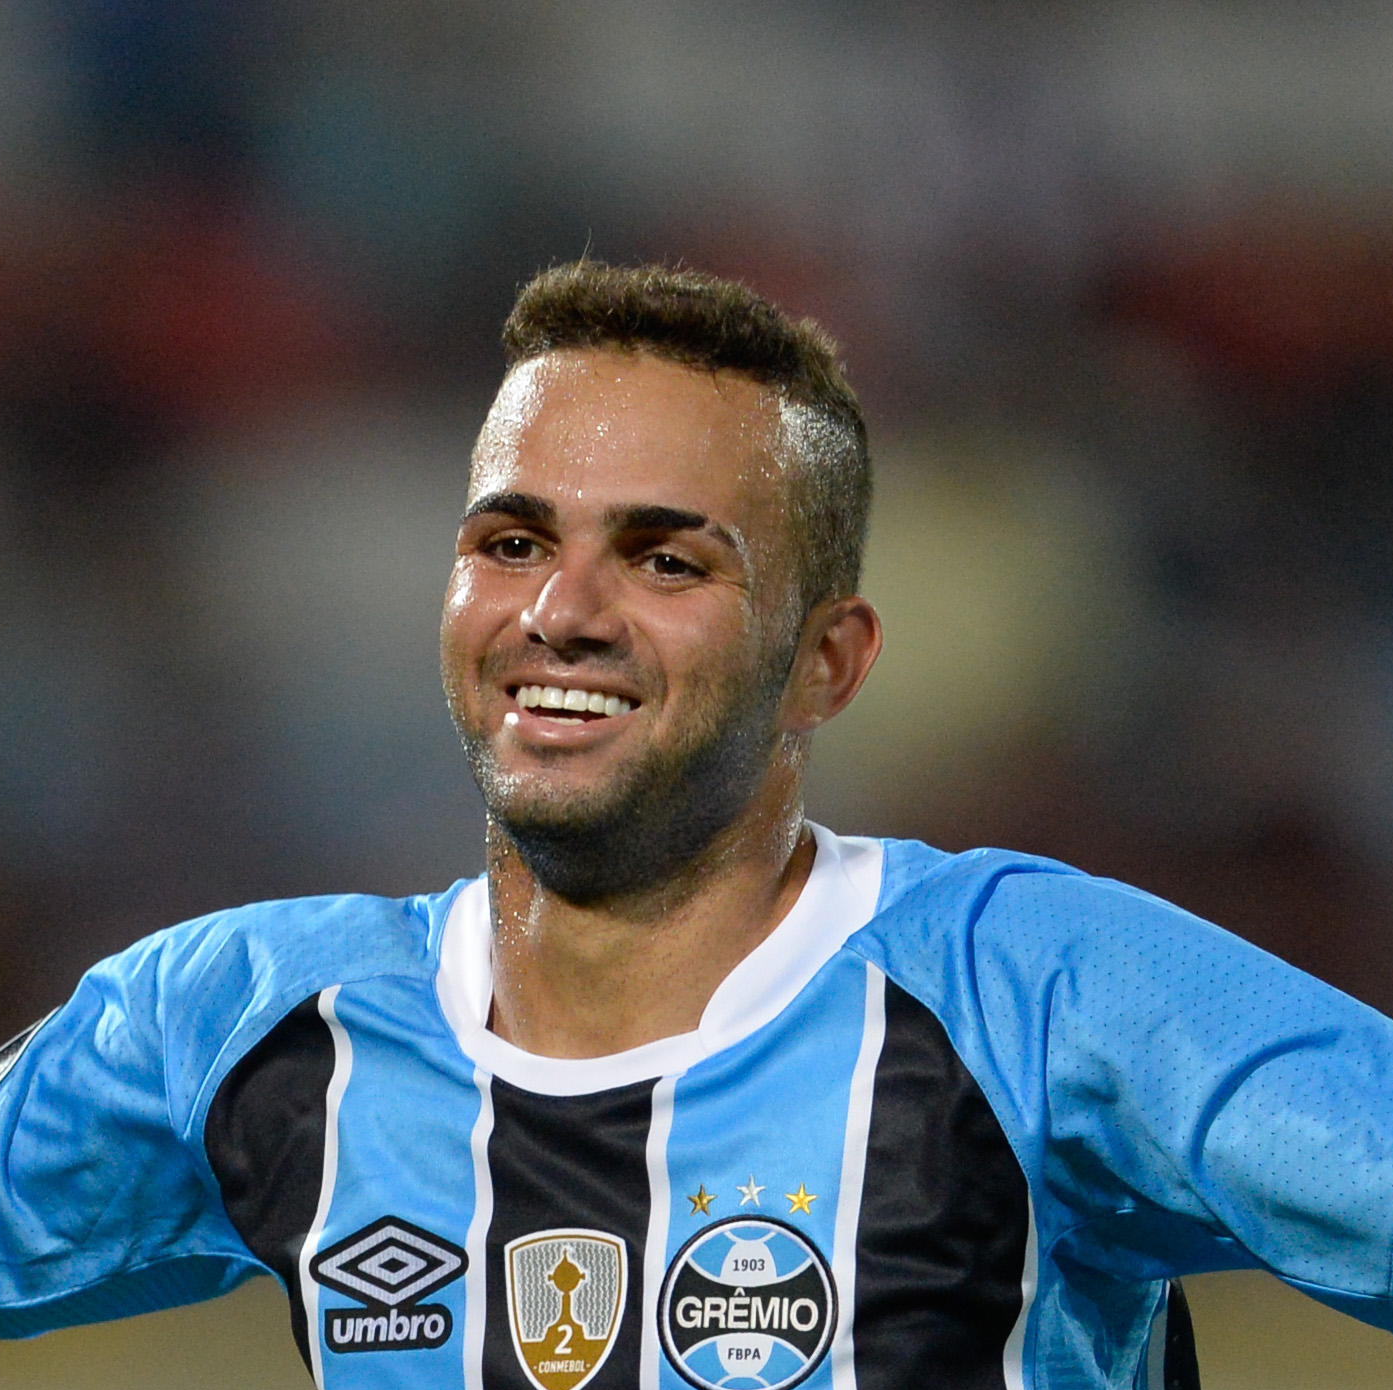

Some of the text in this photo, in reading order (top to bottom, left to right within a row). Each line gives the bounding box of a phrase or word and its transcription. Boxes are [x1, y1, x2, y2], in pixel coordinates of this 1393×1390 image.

[732, 1258, 765, 1272] 1903
[675, 1286, 819, 1332] GRÊMIO
[332, 1307, 445, 1344] umbro
[553, 1324, 573, 1355] 2
[727, 1347, 761, 1360] FBPA
[538, 1359, 586, 1374] CONMEBOL
